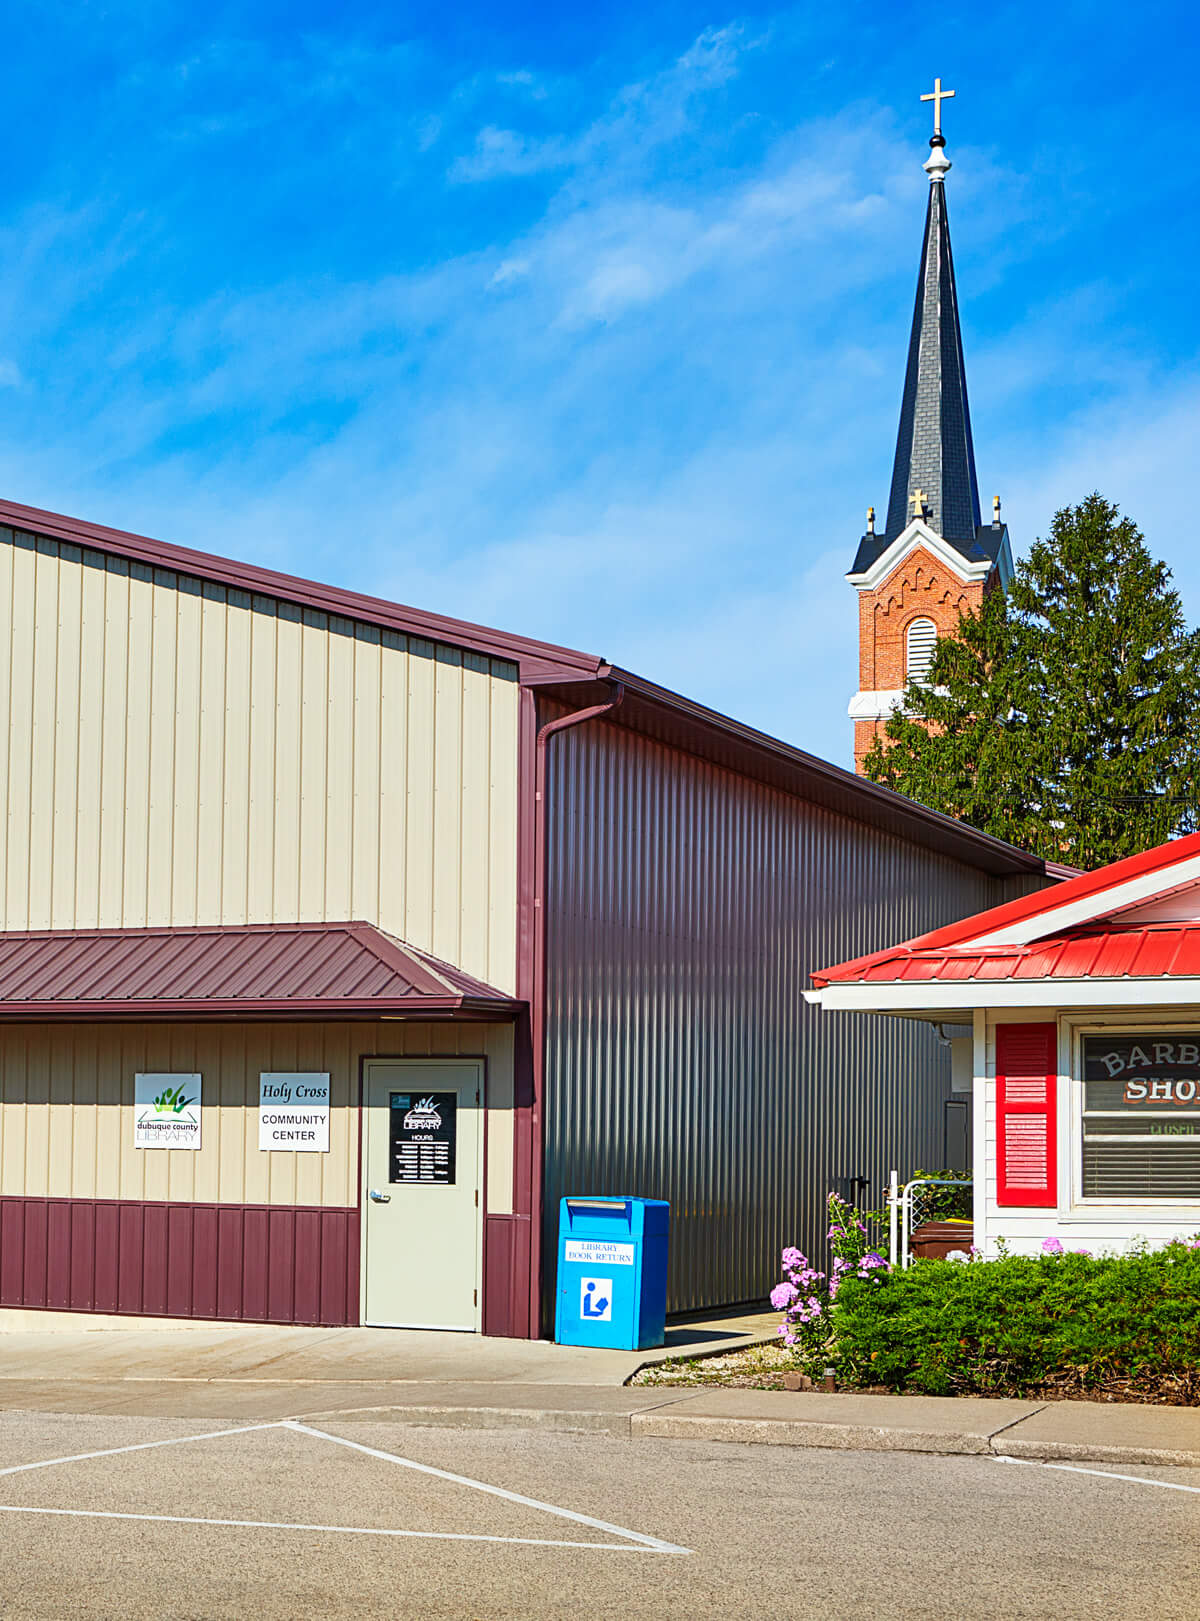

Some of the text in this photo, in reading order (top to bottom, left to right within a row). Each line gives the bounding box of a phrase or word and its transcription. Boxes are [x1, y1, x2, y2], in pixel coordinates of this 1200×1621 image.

[1101, 1043, 1200, 1077] BARB
[263, 1082, 327, 1103] Holy Cross
[1124, 1077, 1200, 1104] SHO
[262, 1114, 326, 1124] COMMUNITY
[137, 1121, 198, 1131] dubuque county
[404, 1120, 440, 1129] LIBRARY
[137, 1130, 196, 1141] LIBRARY
[272, 1131, 315, 1140] CENTER
[581, 1243, 617, 1252] LIBRARY
[569, 1251, 631, 1262] BOOK RETURN
